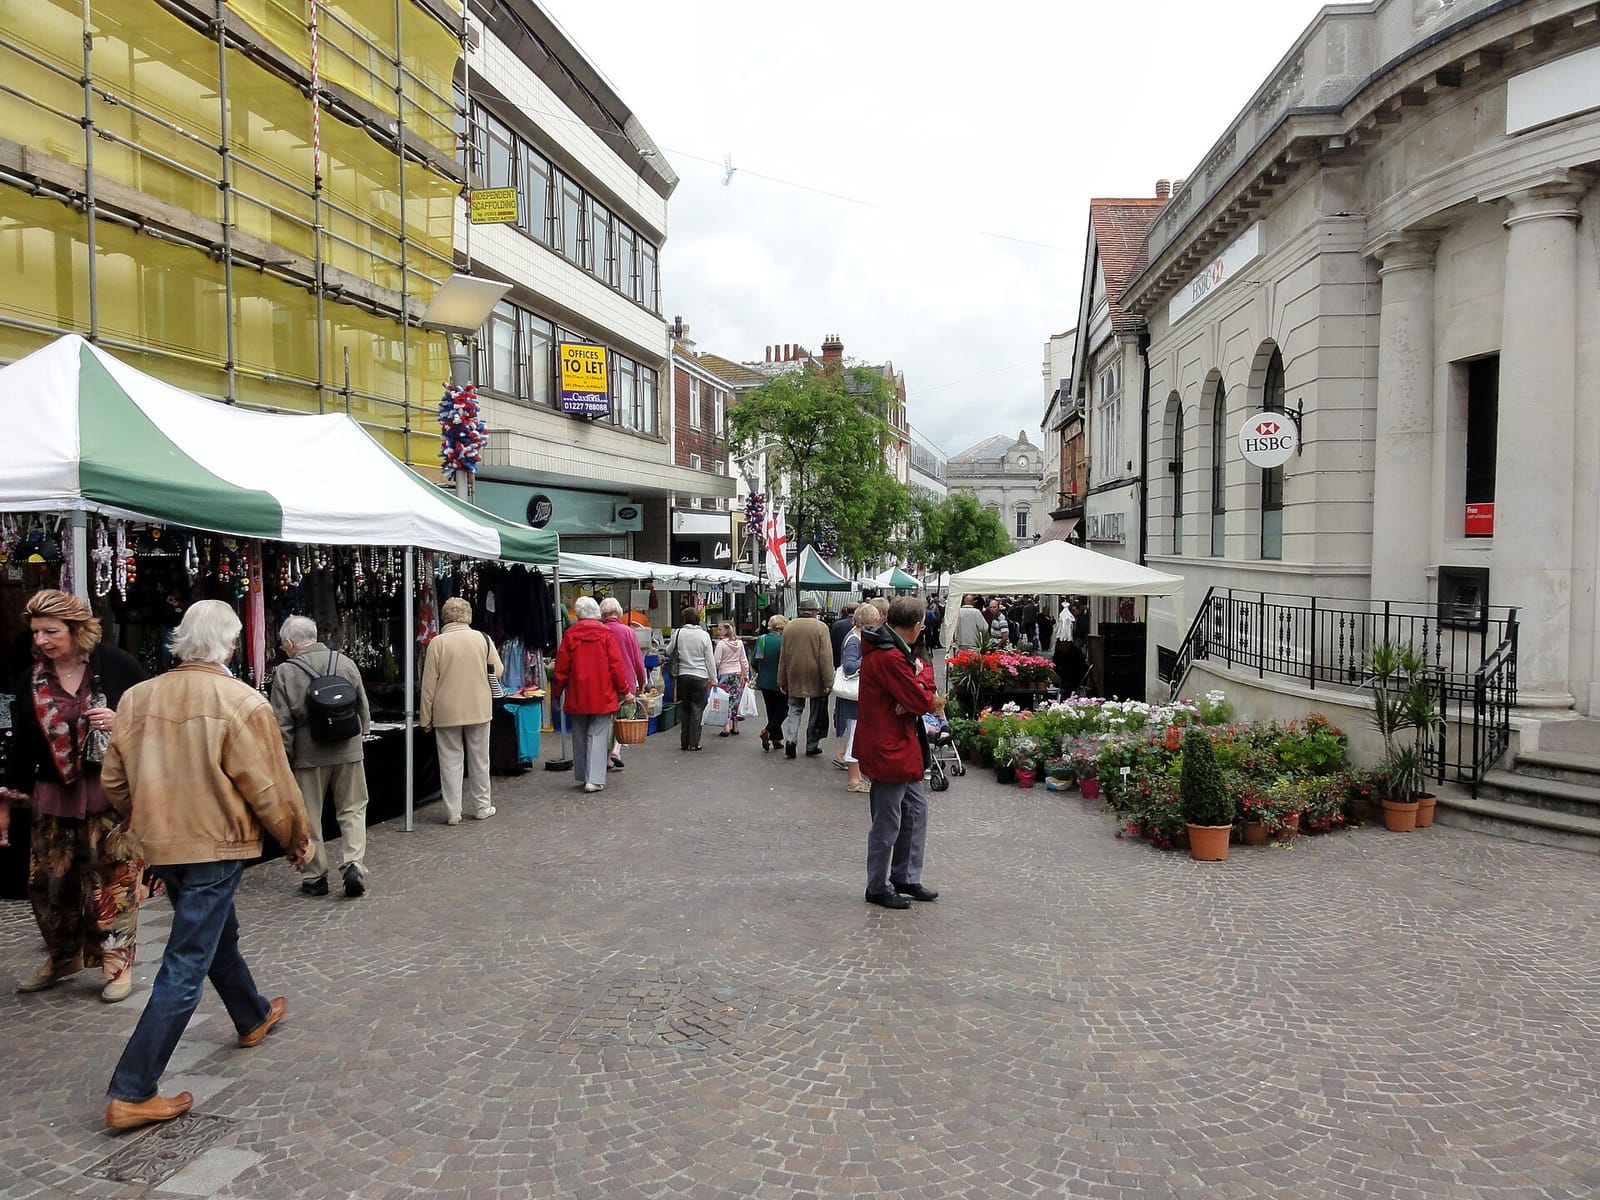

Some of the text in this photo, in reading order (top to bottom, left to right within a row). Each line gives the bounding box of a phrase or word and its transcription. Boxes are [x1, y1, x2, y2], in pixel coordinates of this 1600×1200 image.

[472, 190, 515, 200] INDEPENDENT
[472, 200, 516, 210] SCAFFOLDING
[1192, 270, 1212, 303] HSBC
[568, 349, 599, 360] OFFICES
[563, 359, 604, 374] TO LET
[564, 402, 584, 410] 01227
[1245, 435, 1292, 452] HSBC
